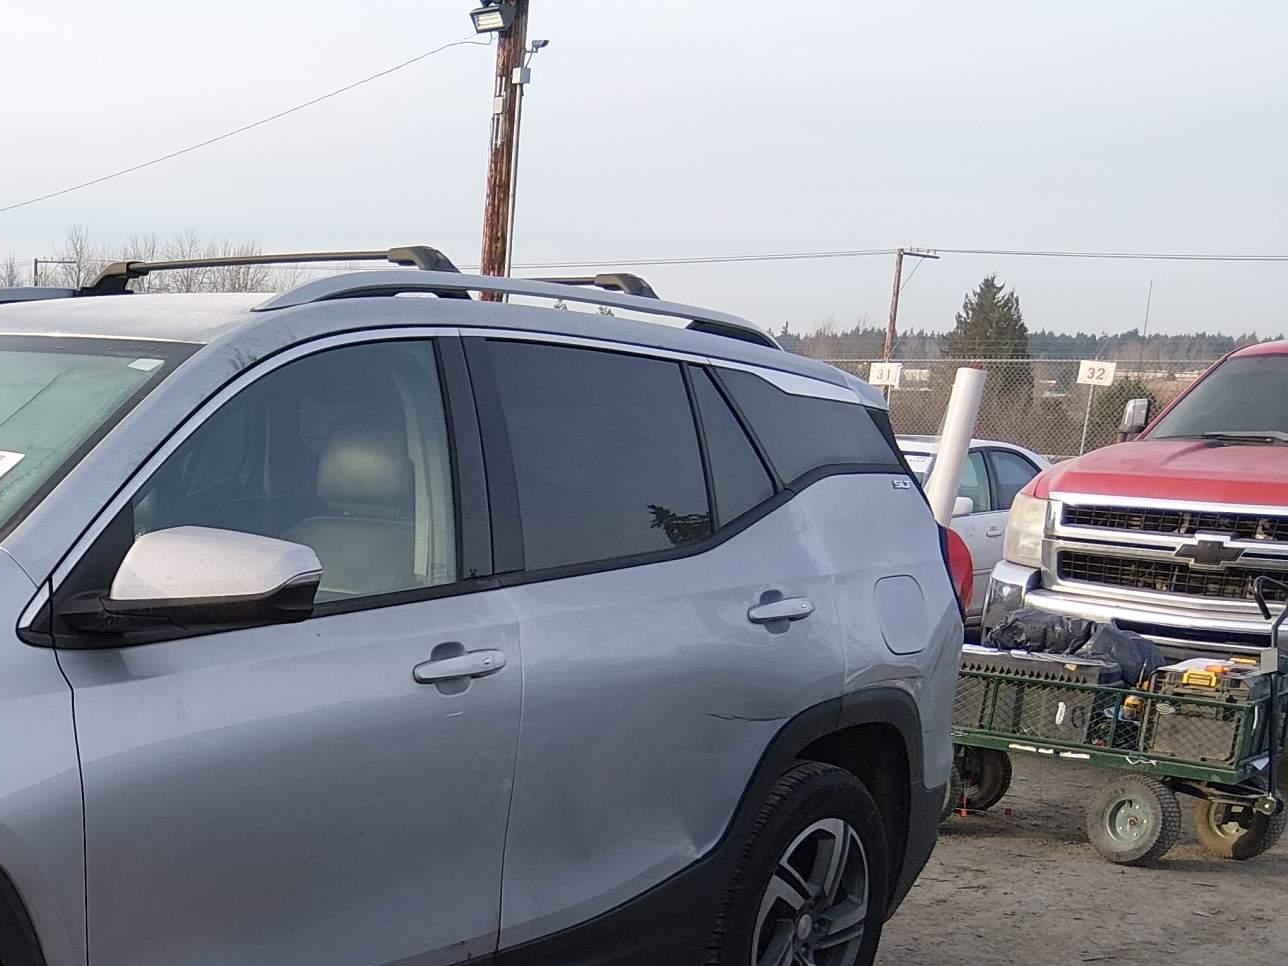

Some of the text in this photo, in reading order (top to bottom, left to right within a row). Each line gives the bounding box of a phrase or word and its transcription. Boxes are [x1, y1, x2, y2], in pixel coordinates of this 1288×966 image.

[876, 368, 891, 380] 31
[1087, 367, 1106, 380] 32
[891, 479, 912, 490] SLT
